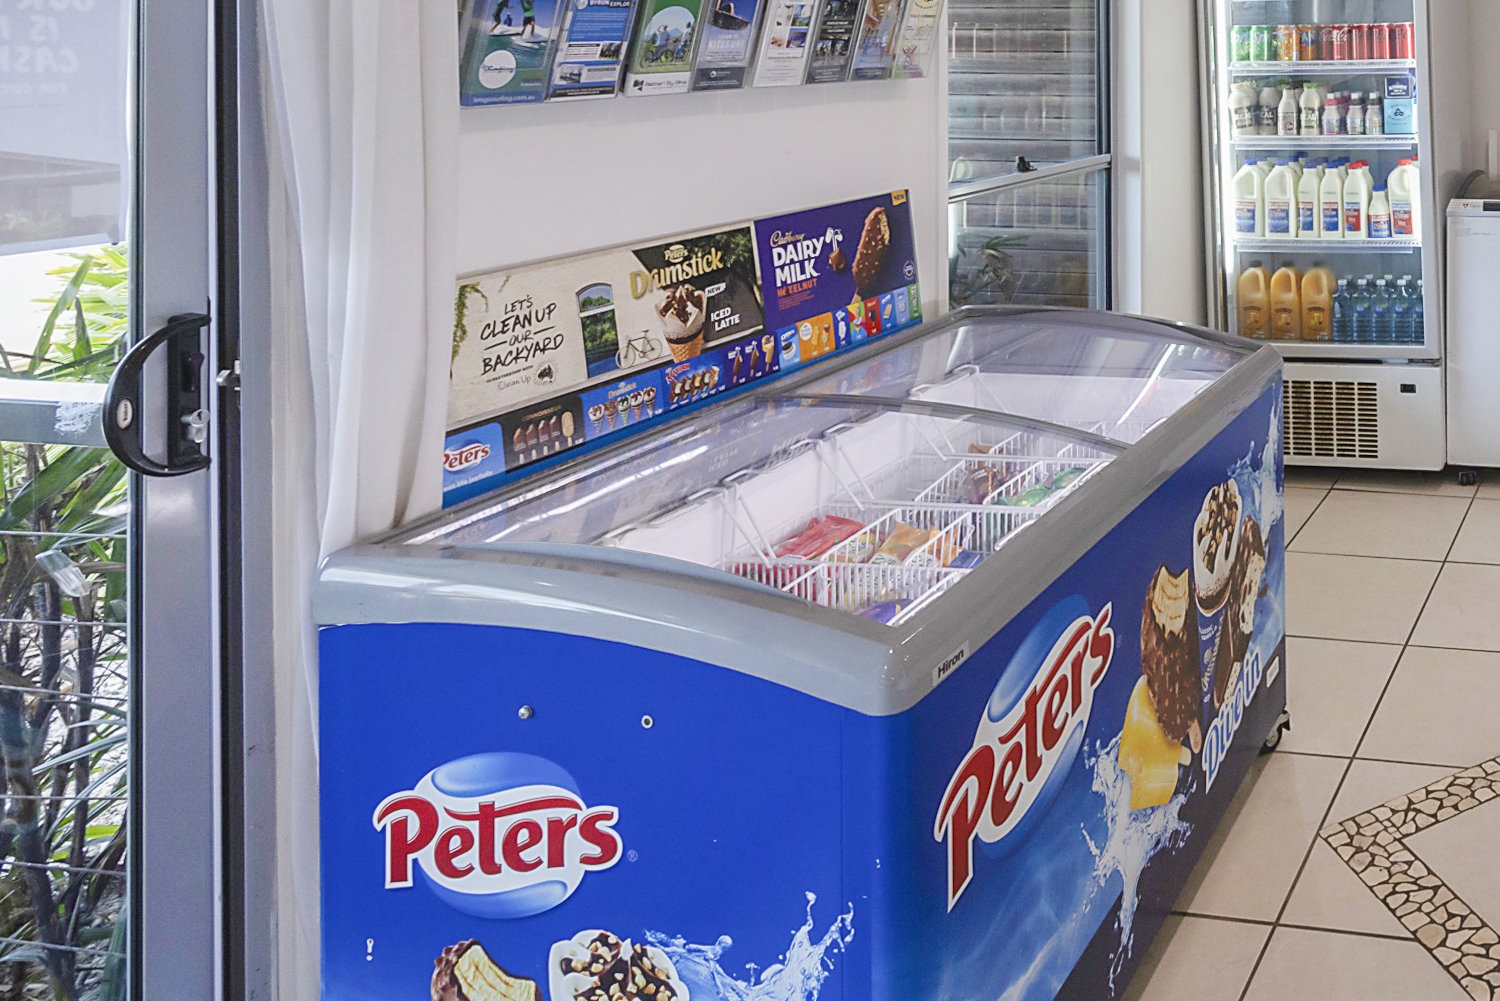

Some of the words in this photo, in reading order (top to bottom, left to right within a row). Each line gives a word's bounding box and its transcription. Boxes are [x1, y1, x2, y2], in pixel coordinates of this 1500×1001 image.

[769, 230, 806, 248] Cadbury
[772, 236, 825, 267] DAIRY
[629, 247, 724, 300] Drumstick
[775, 259, 819, 288] MILK
[777, 278, 818, 298] HAZELNUT
[504, 294, 533, 315] LET'S
[707, 285, 721, 295] NEW
[480, 309, 532, 341] CLEAN
[535, 302, 557, 323] UP
[710, 306, 732, 322] ICED
[714, 314, 740, 332] LATTE
[508, 330, 534, 347] OUR
[481, 333, 564, 377] BACKYARD
[497, 380, 520, 391] Clean
[520, 374, 532, 385] Up
[937, 648, 965, 679] Hiron
[1243, 649, 1263, 707] in
[936, 602, 1113, 910] Peters
[376, 794, 619, 884] Peters
